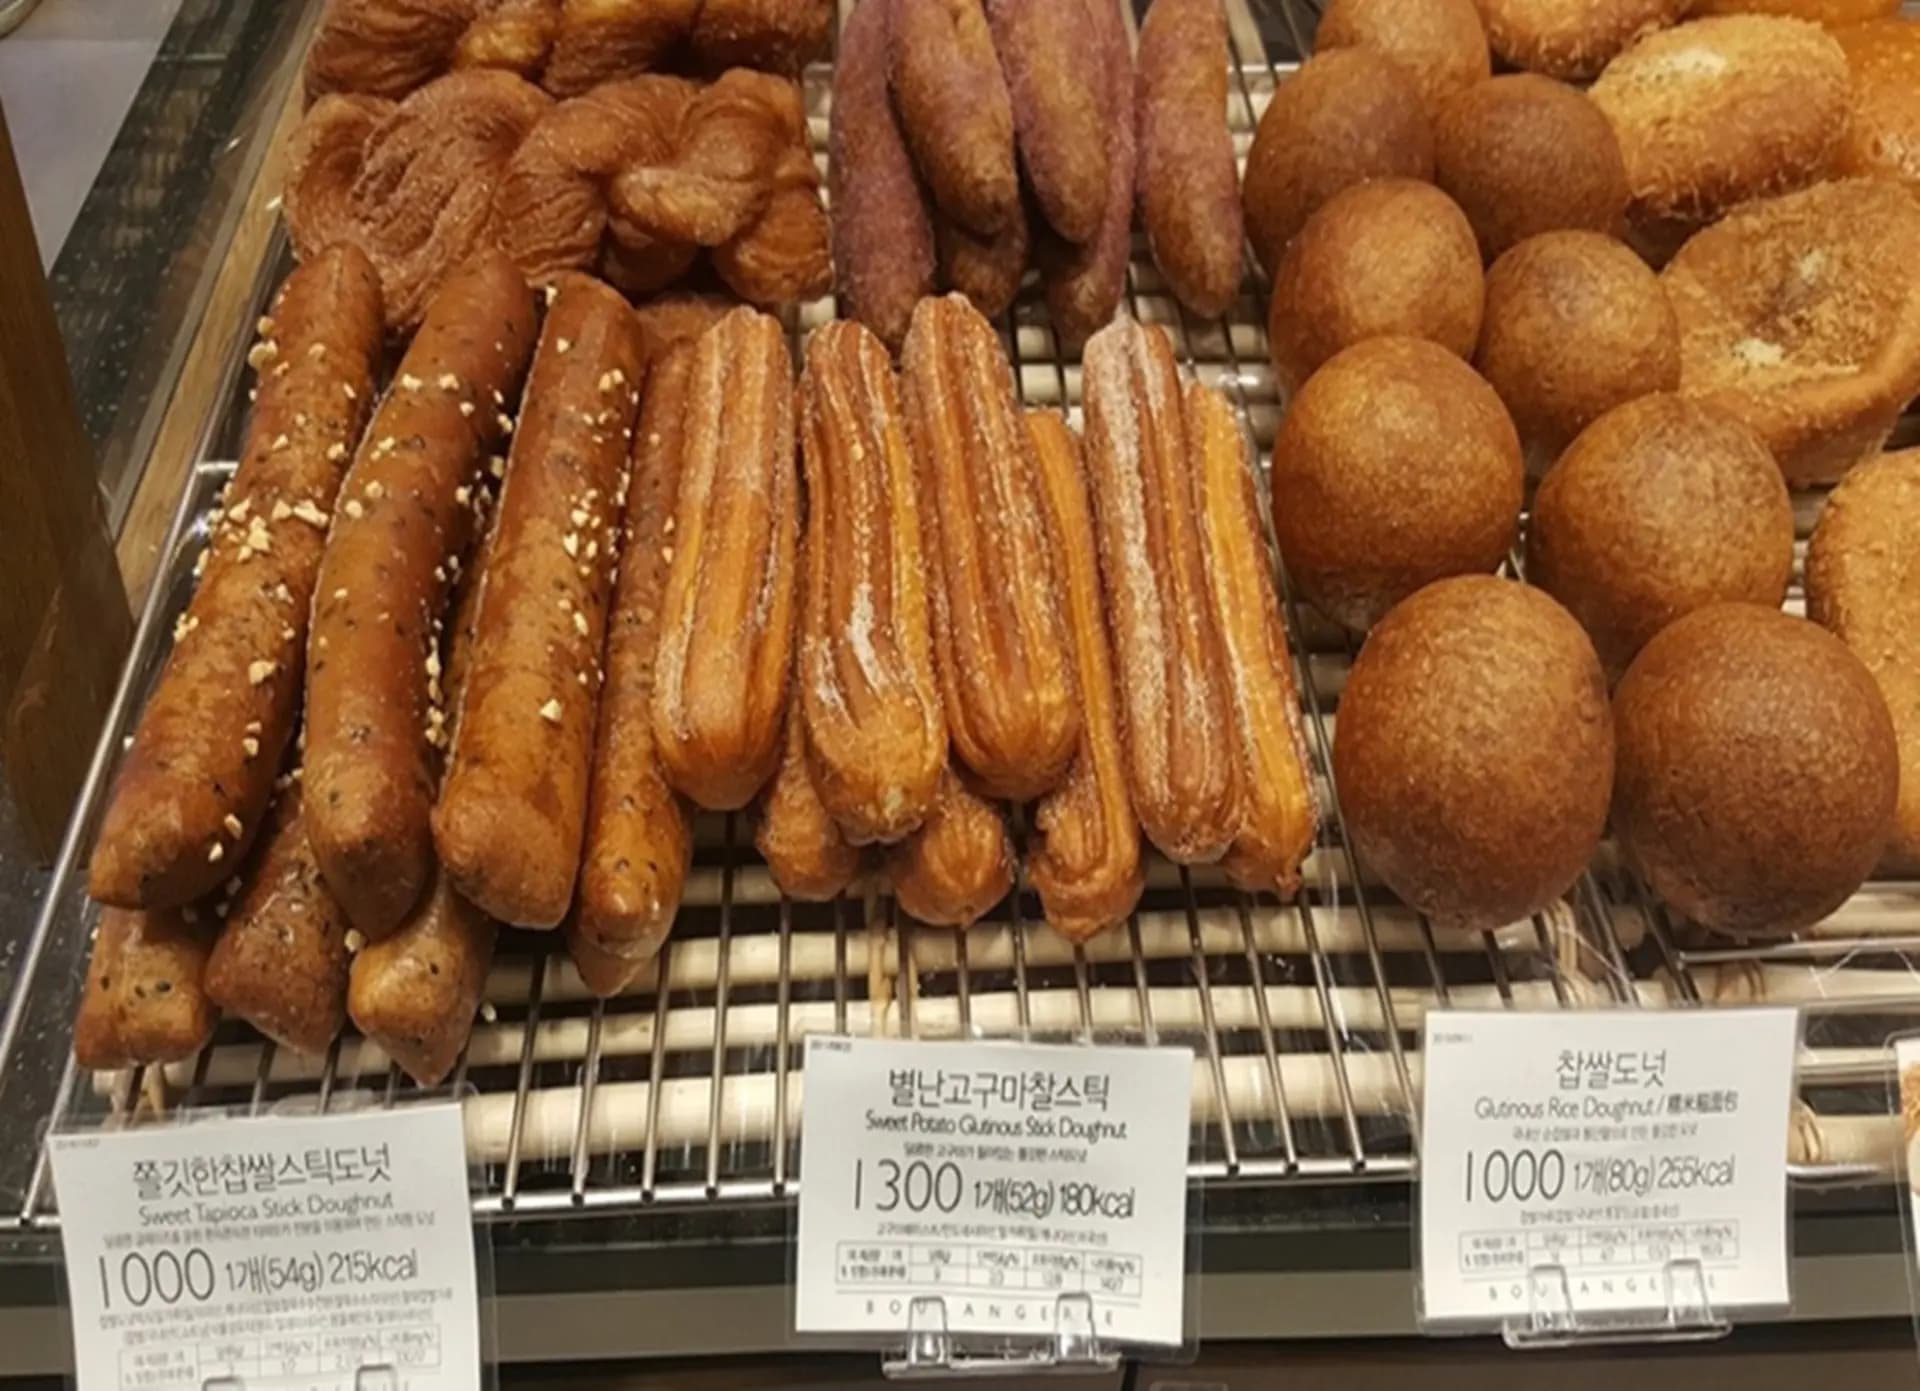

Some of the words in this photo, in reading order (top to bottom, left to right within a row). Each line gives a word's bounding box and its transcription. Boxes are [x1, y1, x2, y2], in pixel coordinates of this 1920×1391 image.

[889, 1068, 1110, 1112] 별난고구마찰스틱
[1556, 1048, 1668, 1090] 찹쌀도넛
[865, 1112, 908, 1132] Sweet
[911, 1113, 956, 1134] Potato
[1026, 1116, 1056, 1137] Stick
[1060, 1118, 1128, 1145] Doughnut
[1548, 1096, 1580, 1118] Rice
[1583, 1095, 1654, 1123] Doughnut
[132, 1142, 392, 1200] 쫄깃한찹쌀스틱도넛
[854, 1158, 963, 1213] 1300
[974, 1178, 1055, 1219] 1개(52g)
[1059, 1182, 1136, 1219] 180kcal
[1465, 1149, 1566, 1203] 1000
[1573, 1156, 1657, 1198] 1개(80g)
[1656, 1155, 1737, 1190] 255kcal
[138, 1204, 192, 1228] Sweet
[197, 1200, 259, 1225] Tapioca
[262, 1196, 301, 1217] Stick
[306, 1192, 394, 1218] Doughnut
[98, 1246, 216, 1309] 1000
[225, 1251, 325, 1296] 1개(54g)
[327, 1249, 419, 1284] 215kcal
